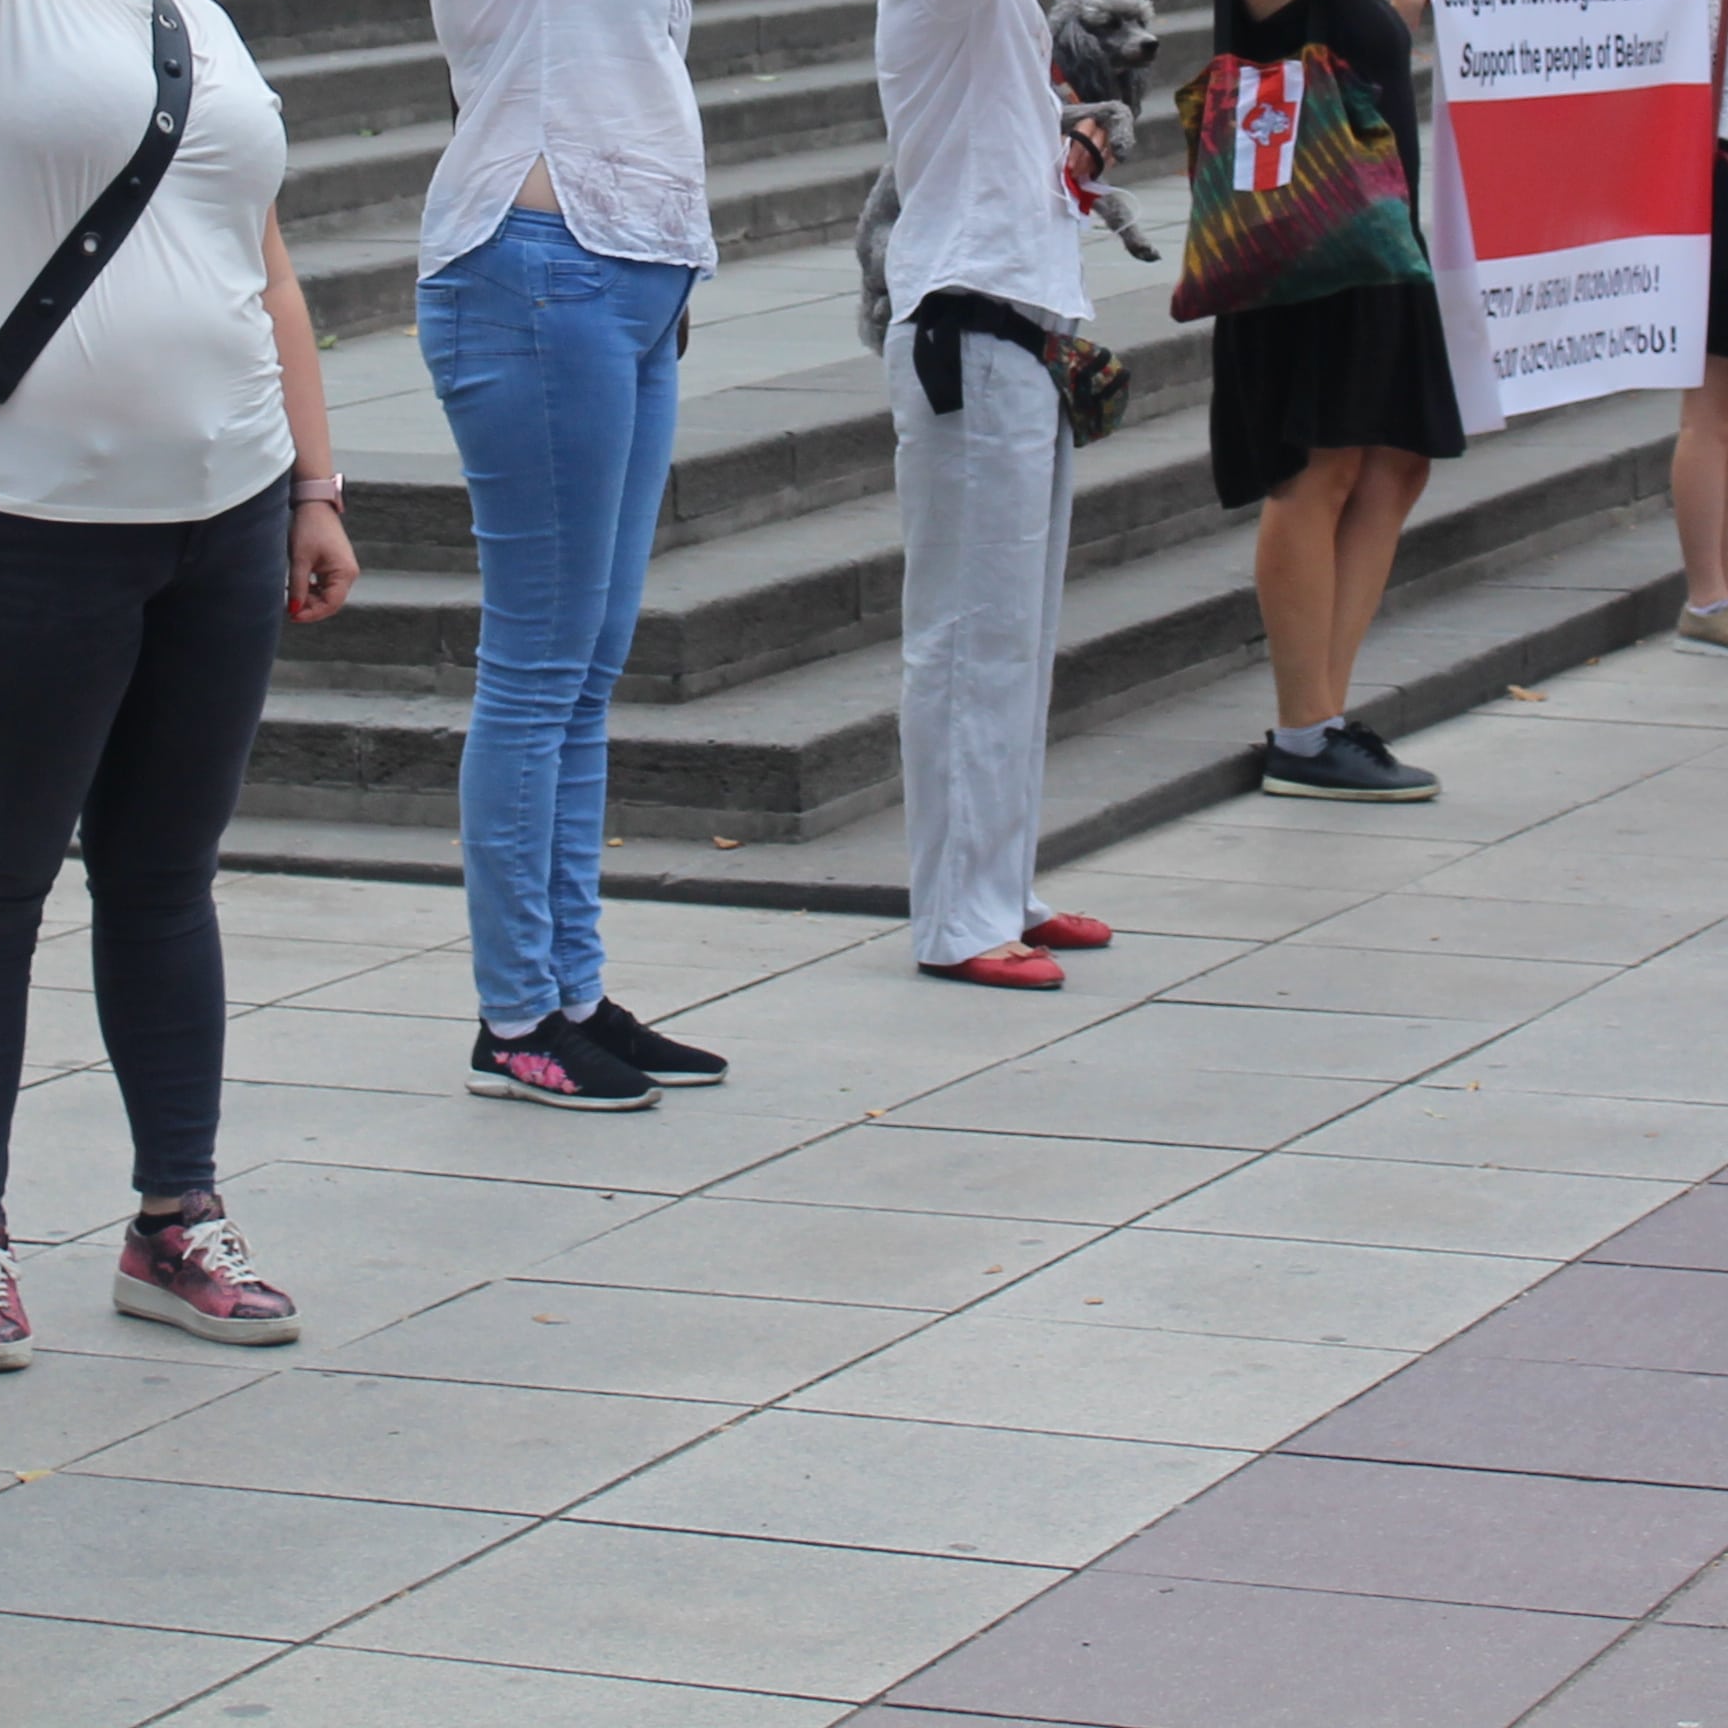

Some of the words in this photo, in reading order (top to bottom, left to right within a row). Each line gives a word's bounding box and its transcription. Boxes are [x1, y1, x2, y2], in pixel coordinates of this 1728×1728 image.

[1460, 41, 1517, 87] Support
[1520, 39, 1541, 74] the
[1545, 36, 1592, 83] people
[1597, 34, 1611, 69] of
